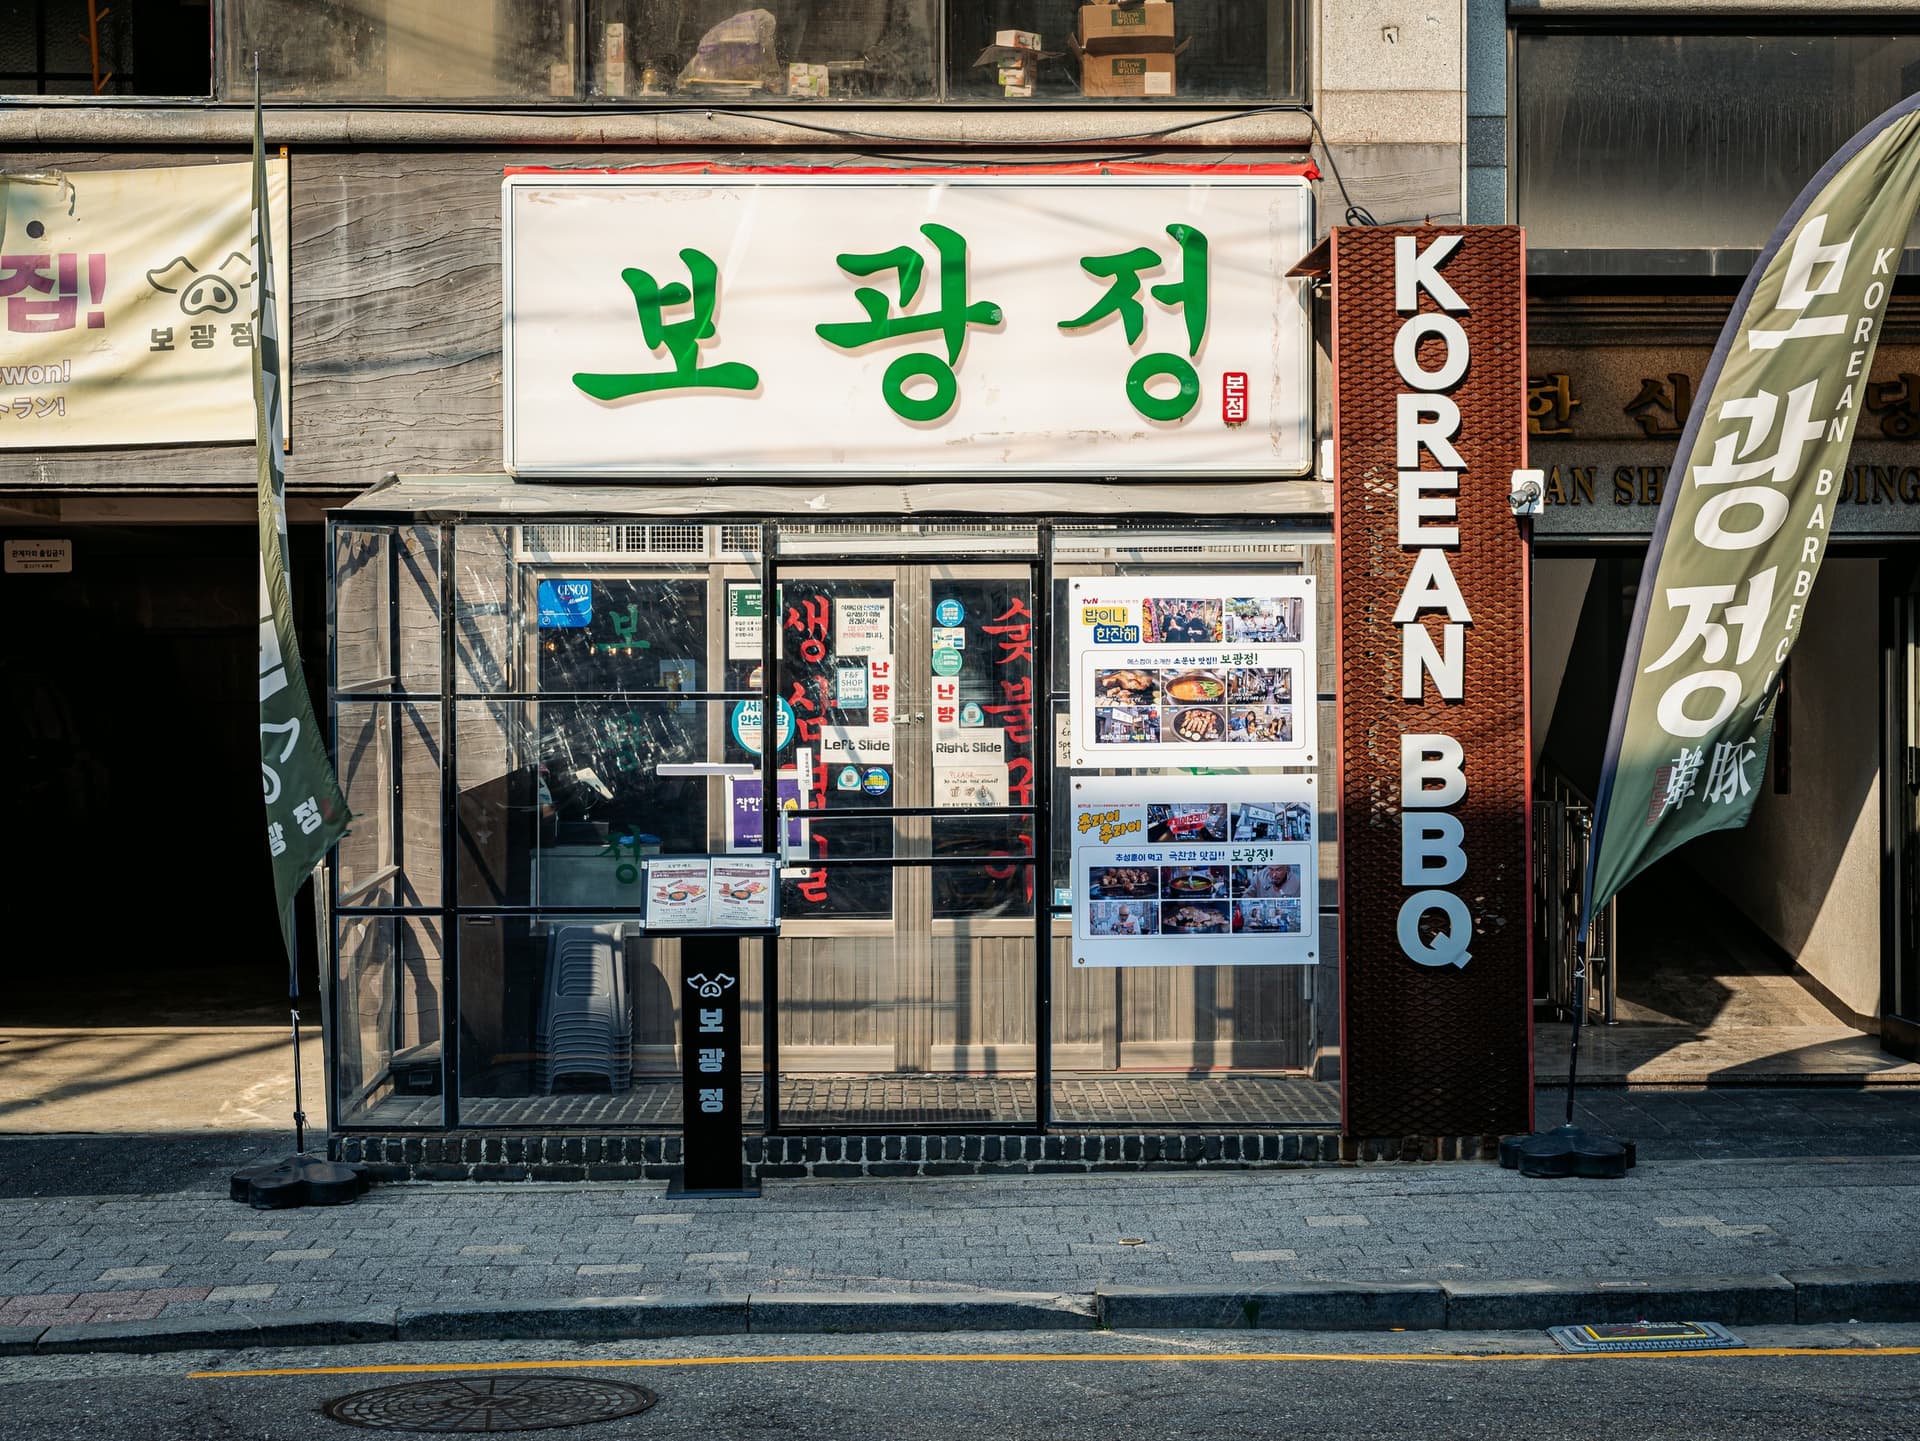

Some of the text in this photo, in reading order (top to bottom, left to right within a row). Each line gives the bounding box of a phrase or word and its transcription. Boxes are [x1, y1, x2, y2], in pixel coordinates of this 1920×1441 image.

[0, 253, 106, 333] 집!
[571, 223, 1209, 422] 보광정
[1826, 248, 1896, 443] KOREAN
[0, 360, 71, 385] won!
[1226, 375, 1245, 418] 본점
[1392, 234, 1473, 700] KOREAN
[1643, 213, 1856, 738] 보광정
[1543, 466, 1597, 506] AN
[557, 584, 589, 596] CESCO
[731, 590, 739, 616] NOTICE
[1085, 608, 1127, 623] 밥이나
[1096, 627, 1137, 642] 한잔해
[1173, 657, 1196, 665] 소문난
[1198, 656, 1218, 665] 맛집!!
[1220, 653, 1258, 665] 보광정!
[824, 739, 890, 751] Left Slide
[935, 742, 1002, 754] Right Slide
[1077, 809, 1120, 835] 추라이
[1099, 819, 1142, 845] 추라이
[1147, 853, 1163, 862] 먹고
[1169, 850, 1197, 862] 극찬한
[1199, 850, 1226, 862] 맛집!!
[1230, 848, 1274, 862] 보광정!
[1396, 733, 1473, 970] BBQ
[699, 1008, 724, 1113] 보광정
